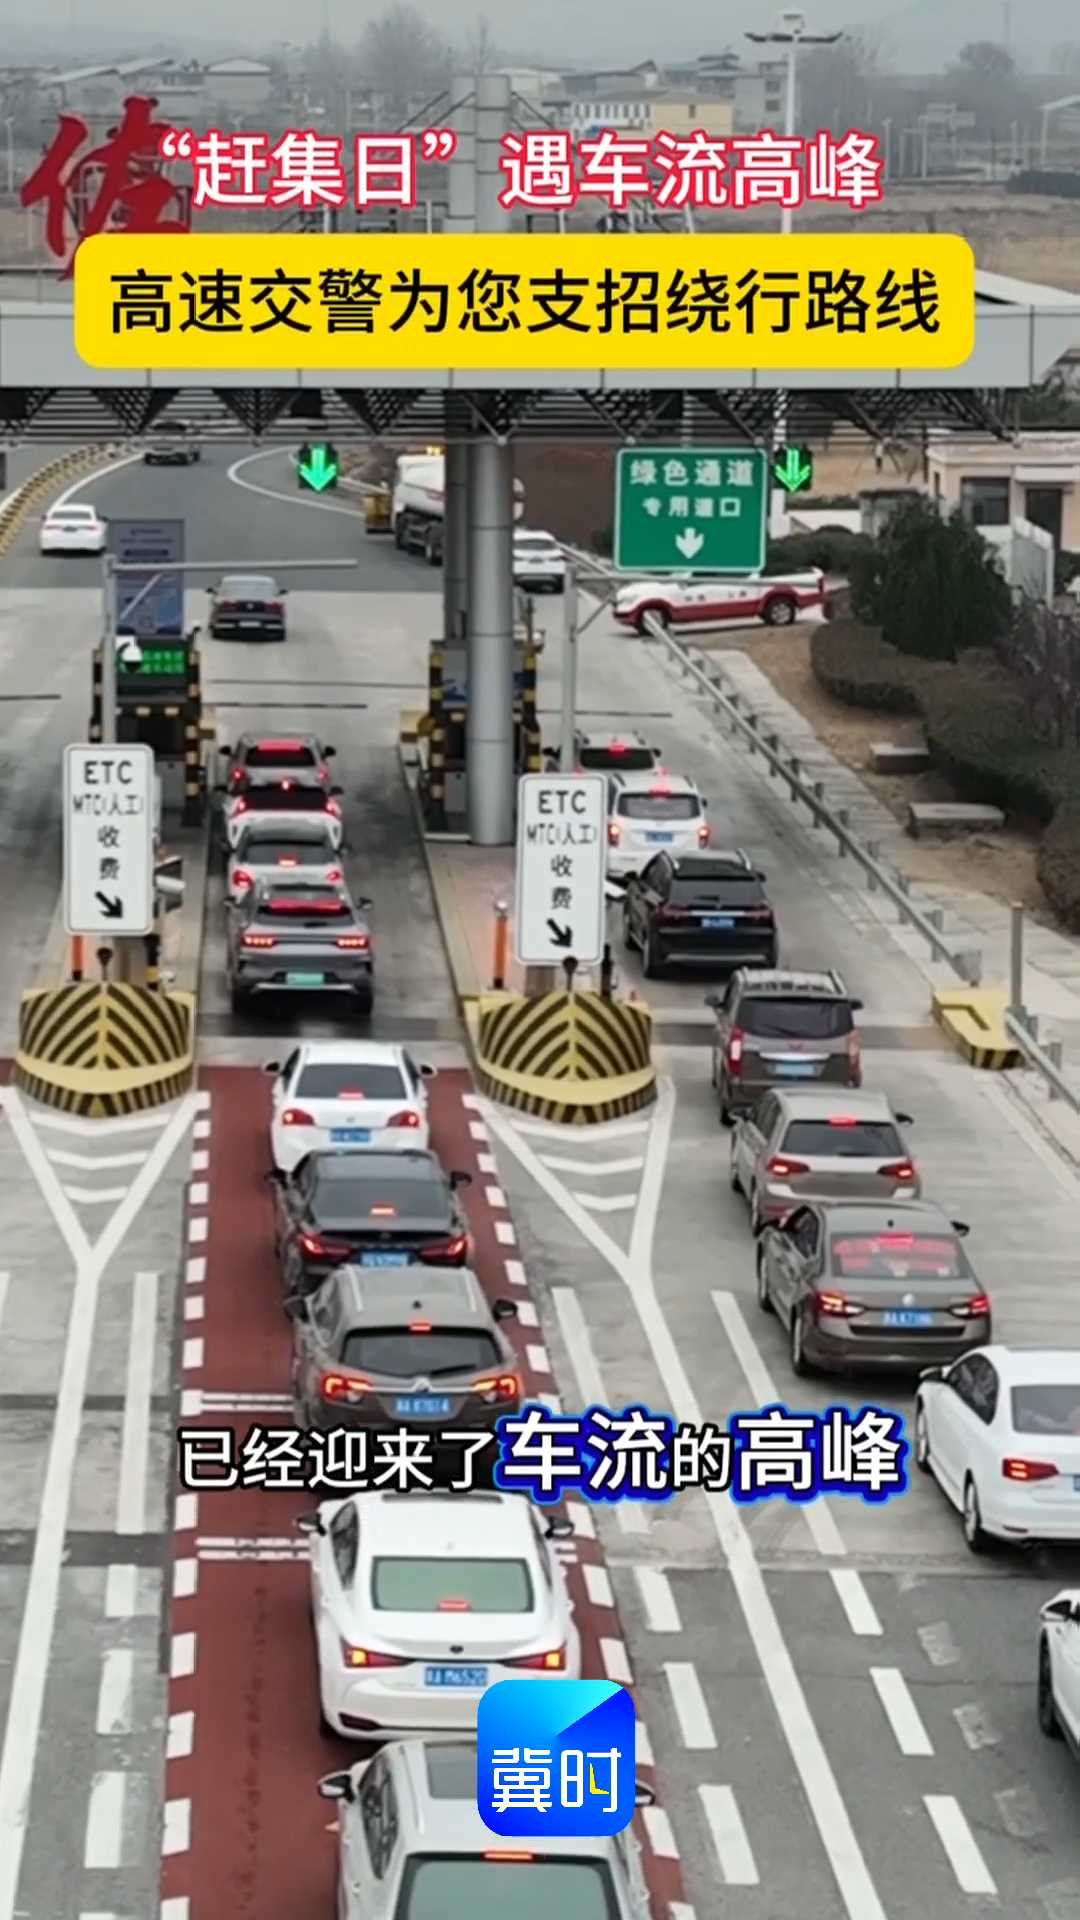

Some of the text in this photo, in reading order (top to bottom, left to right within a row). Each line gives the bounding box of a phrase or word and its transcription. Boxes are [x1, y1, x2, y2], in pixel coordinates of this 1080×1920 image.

[630, 459, 754, 487] 绿色通道
[642, 495, 741, 517] 专用道口
[84, 760, 133, 785] ETC
[538, 789, 587, 815] ETC
